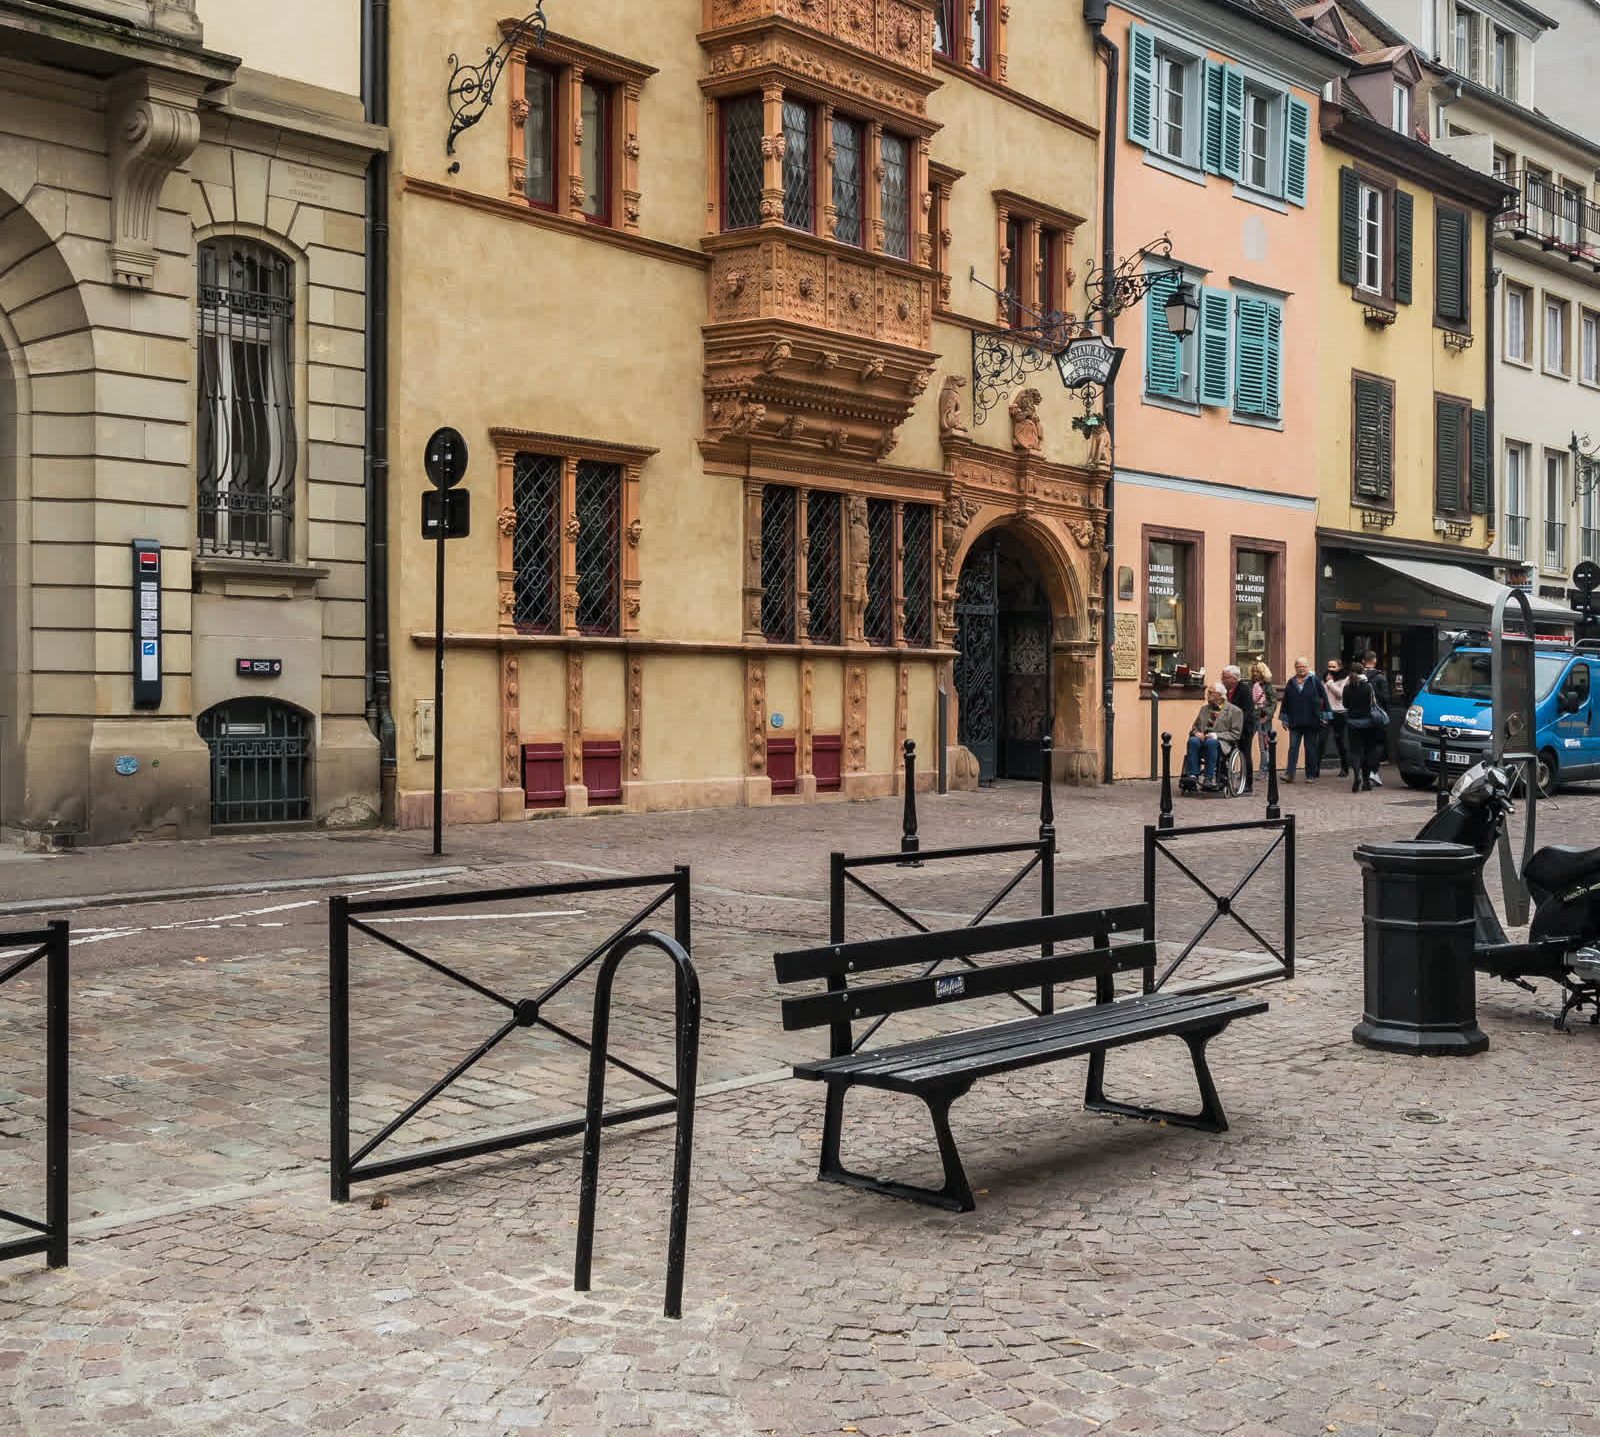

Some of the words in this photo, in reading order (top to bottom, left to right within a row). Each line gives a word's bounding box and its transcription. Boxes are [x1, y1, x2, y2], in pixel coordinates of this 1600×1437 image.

[1060, 345, 1114, 367] RESTAURANT
[1073, 358, 1100, 370] MAISON
[1065, 370, 1081, 385] DES
[1148, 564, 1174, 573] LIBRAIRIE
[1149, 575, 1174, 584] ANCIENNE
[1248, 574, 1264, 582] VENTE
[1148, 586, 1174, 595] RICHARD
